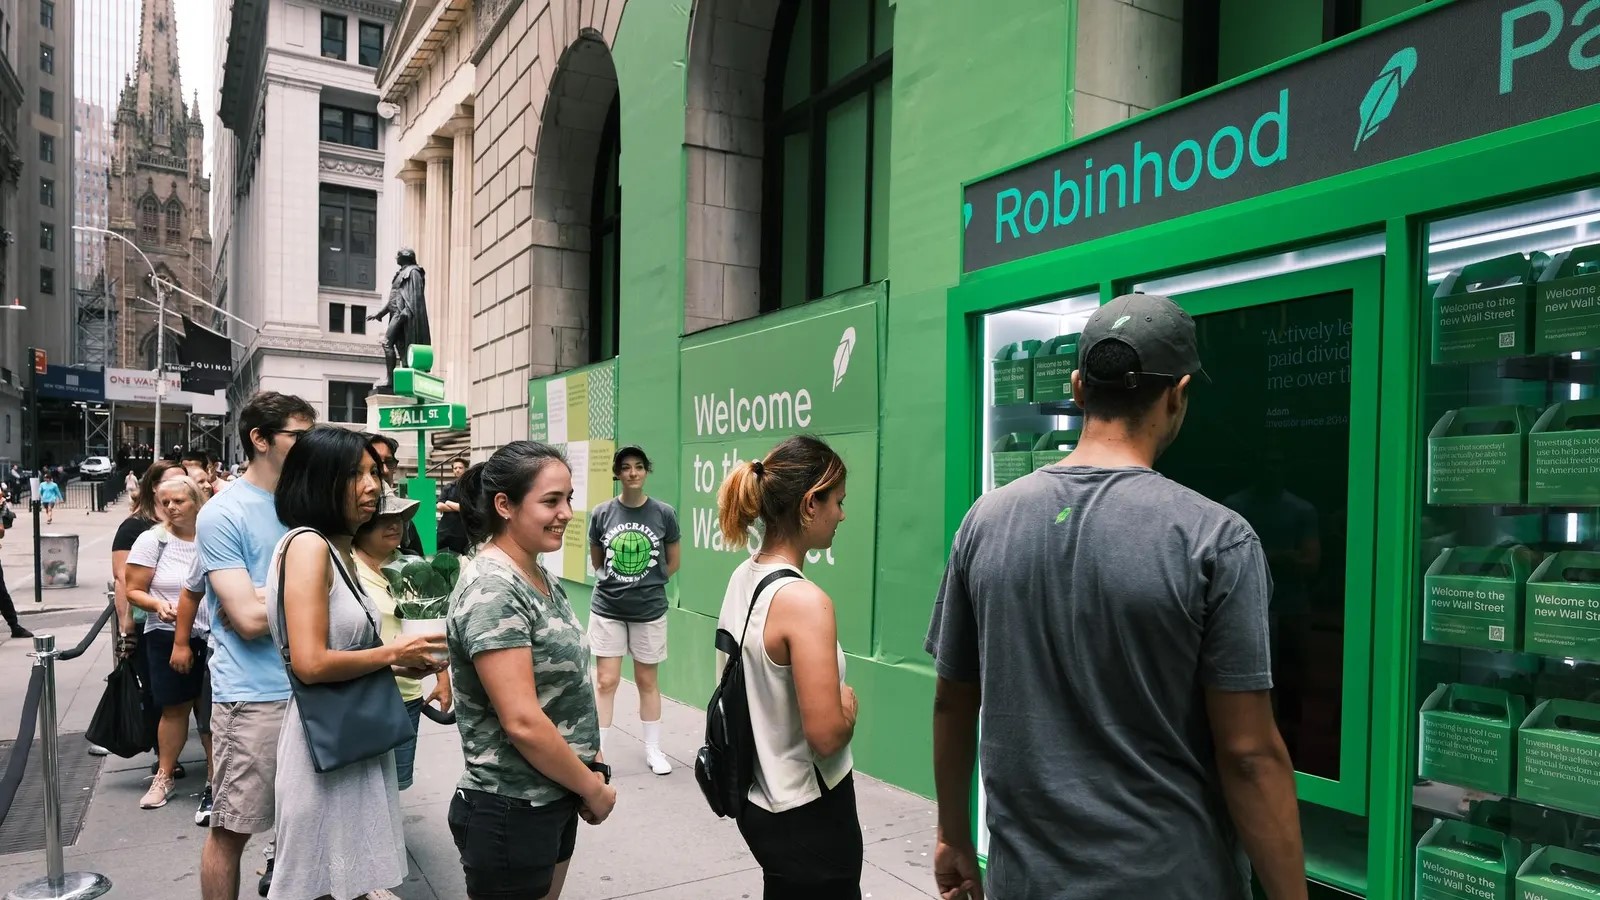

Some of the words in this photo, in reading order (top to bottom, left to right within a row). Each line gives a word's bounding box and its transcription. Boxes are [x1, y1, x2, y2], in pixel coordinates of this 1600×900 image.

[995, 88, 1289, 243] Robinhood
[1545, 285, 1596, 300] Welcome
[1440, 302, 1484, 314] Welcome
[1486, 300, 1496, 308] to
[1499, 296, 1515, 306] the
[1545, 302, 1568, 312] new
[1570, 297, 1594, 309] Wall
[1440, 317, 1459, 326] new
[1462, 312, 1482, 323] Wall
[1484, 309, 1515, 320] Street
[1268, 346, 1303, 371] paid
[1307, 341, 1350, 362] divid
[190, 361, 231, 372] EQUINOX
[110, 376, 130, 385] ONE
[1268, 374, 1293, 389] me
[1297, 369, 1336, 387] over
[694, 388, 811, 435] Welcome
[1561, 447, 1579, 456] help
[694, 454, 715, 493] to
[603, 522, 660, 548] DEMOCRATIZE
[1431, 586, 1474, 598] Welcome
[1476, 591, 1486, 599] to
[1488, 591, 1505, 600] the
[1453, 600, 1472, 610] Wall
[1474, 601, 1505, 613] Street
[1535, 594, 1585, 607] Welcome
[1588, 599, 1600, 608] to
[1535, 608, 1557, 617] new
[1560, 609, 1583, 620] Wall
[1446, 731, 1461, 741] help
[1462, 735, 1489, 746] achieve
[1469, 728, 1483, 736] tool
[1453, 742, 1483, 753] freedom
[1484, 748, 1498, 756] and
[1525, 748, 1539, 756] use
[1541, 750, 1549, 758] to
[1550, 751, 1567, 762] help
[1576, 748, 1593, 757] tool
[1525, 756, 1558, 769] financial
[1558, 762, 1592, 775] freedom
[1525, 765, 1537, 774] the
[1539, 767, 1576, 782] American
[1422, 860, 1464, 880] Welcome
[1466, 873, 1477, 883] to
[1478, 877, 1495, 888] the
[1422, 872, 1441, 884] new
[1443, 877, 1463, 890] Wall
[1464, 884, 1495, 900] Street
[1540, 876, 1596, 894] Robinhood
